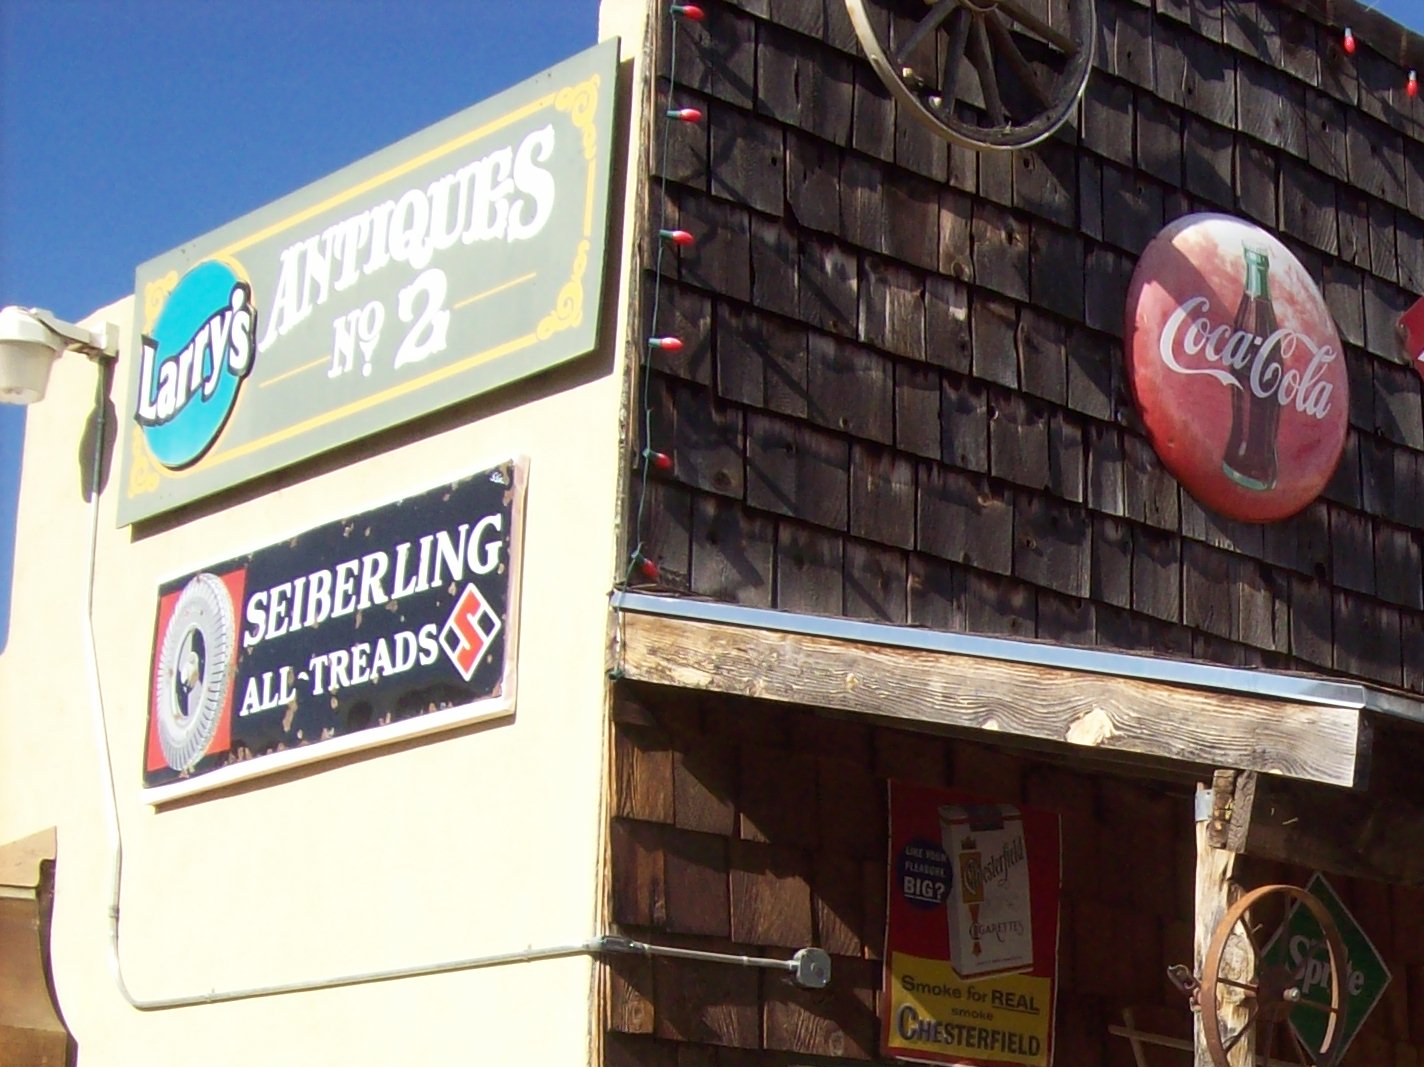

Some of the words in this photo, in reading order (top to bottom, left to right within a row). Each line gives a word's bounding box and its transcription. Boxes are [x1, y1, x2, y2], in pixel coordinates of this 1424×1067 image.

[258, 123, 556, 353] ANTIQUES
[138, 286, 255, 422] Larry's
[394, 268, 451, 369] 2
[1159, 296, 1338, 420] Coca-Cola
[242, 512, 503, 649] SEIBERLING
[903, 875, 946, 899] BIG?
[896, 1003, 1042, 1057] CHESTERFIELD
[900, 974, 962, 999] Smoke
[966, 985, 988, 1004] for
[991, 989, 1040, 1013] REAL
[950, 1006, 994, 1022] smoke
